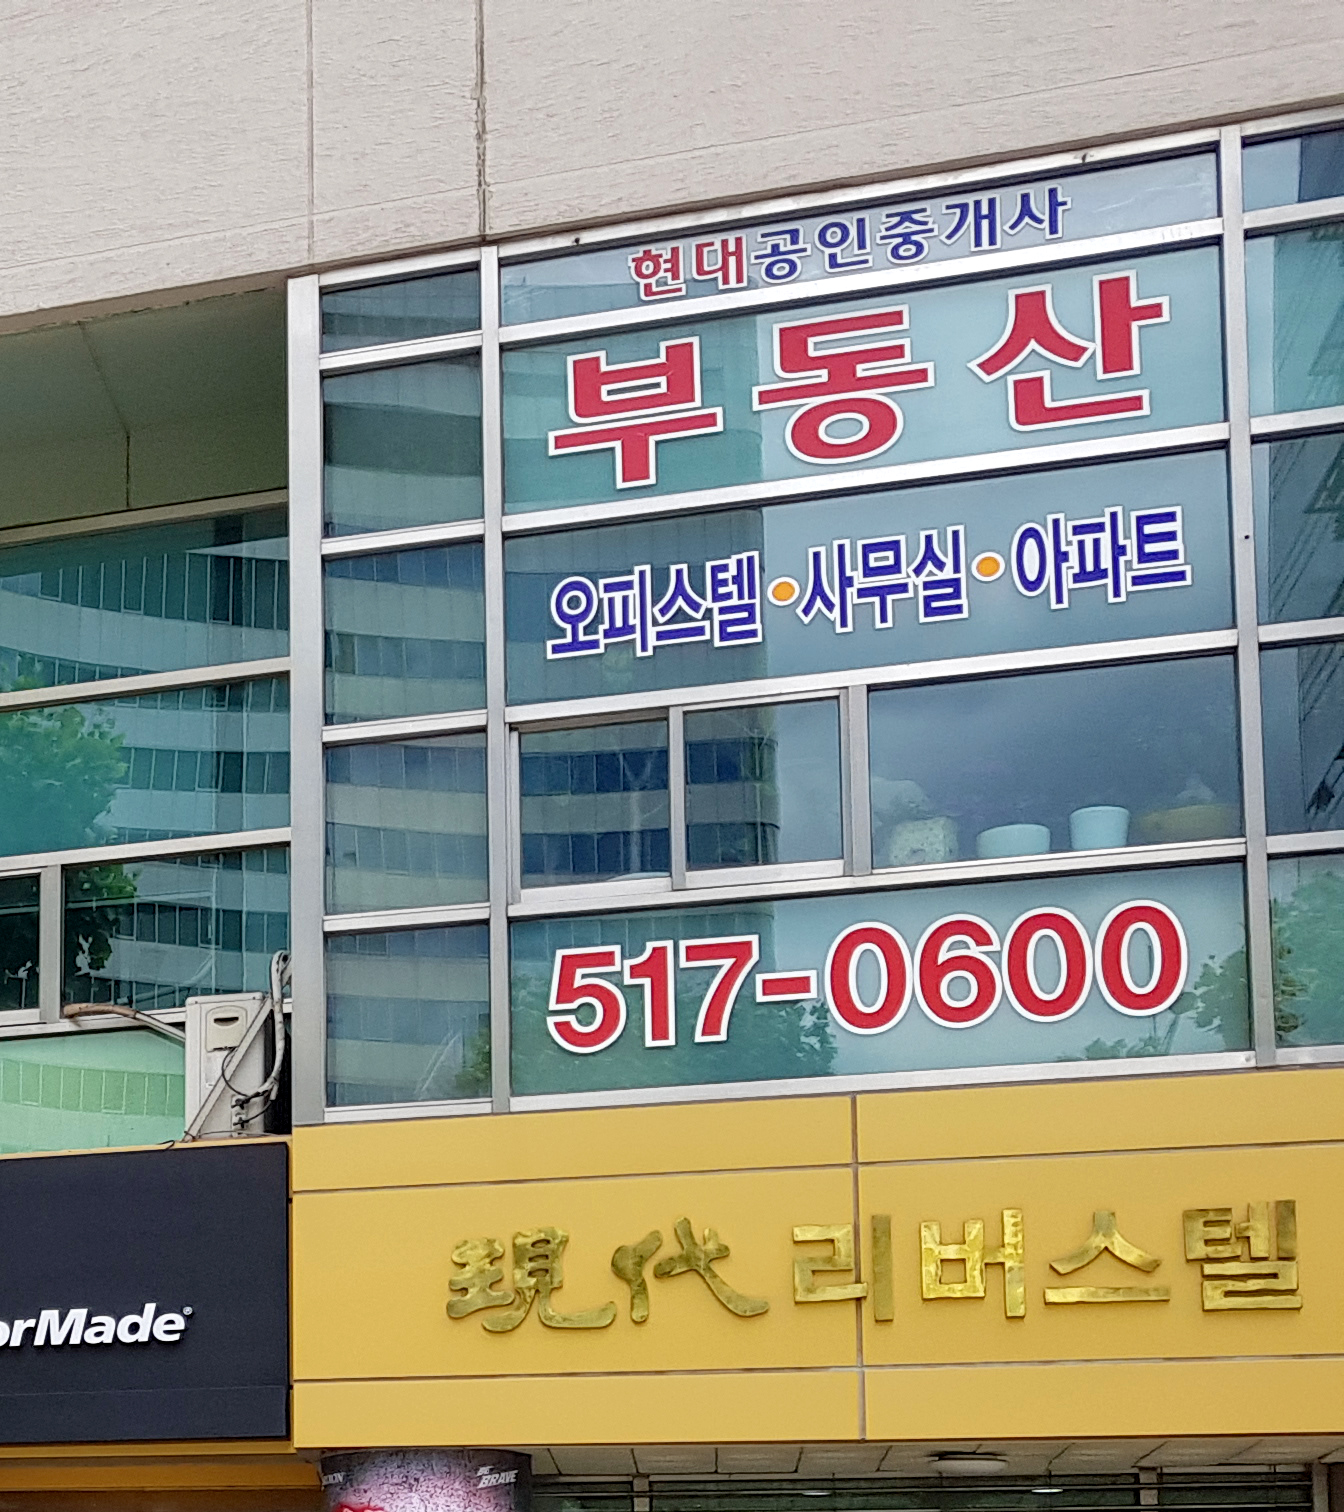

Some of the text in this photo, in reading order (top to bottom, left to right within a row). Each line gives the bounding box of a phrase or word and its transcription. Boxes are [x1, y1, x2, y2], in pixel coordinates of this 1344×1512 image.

[548, 271, 1170, 489] 부동산
[547, 900, 1189, 1053] 517-0600
[477, 1470, 518, 1488] BRAVE
